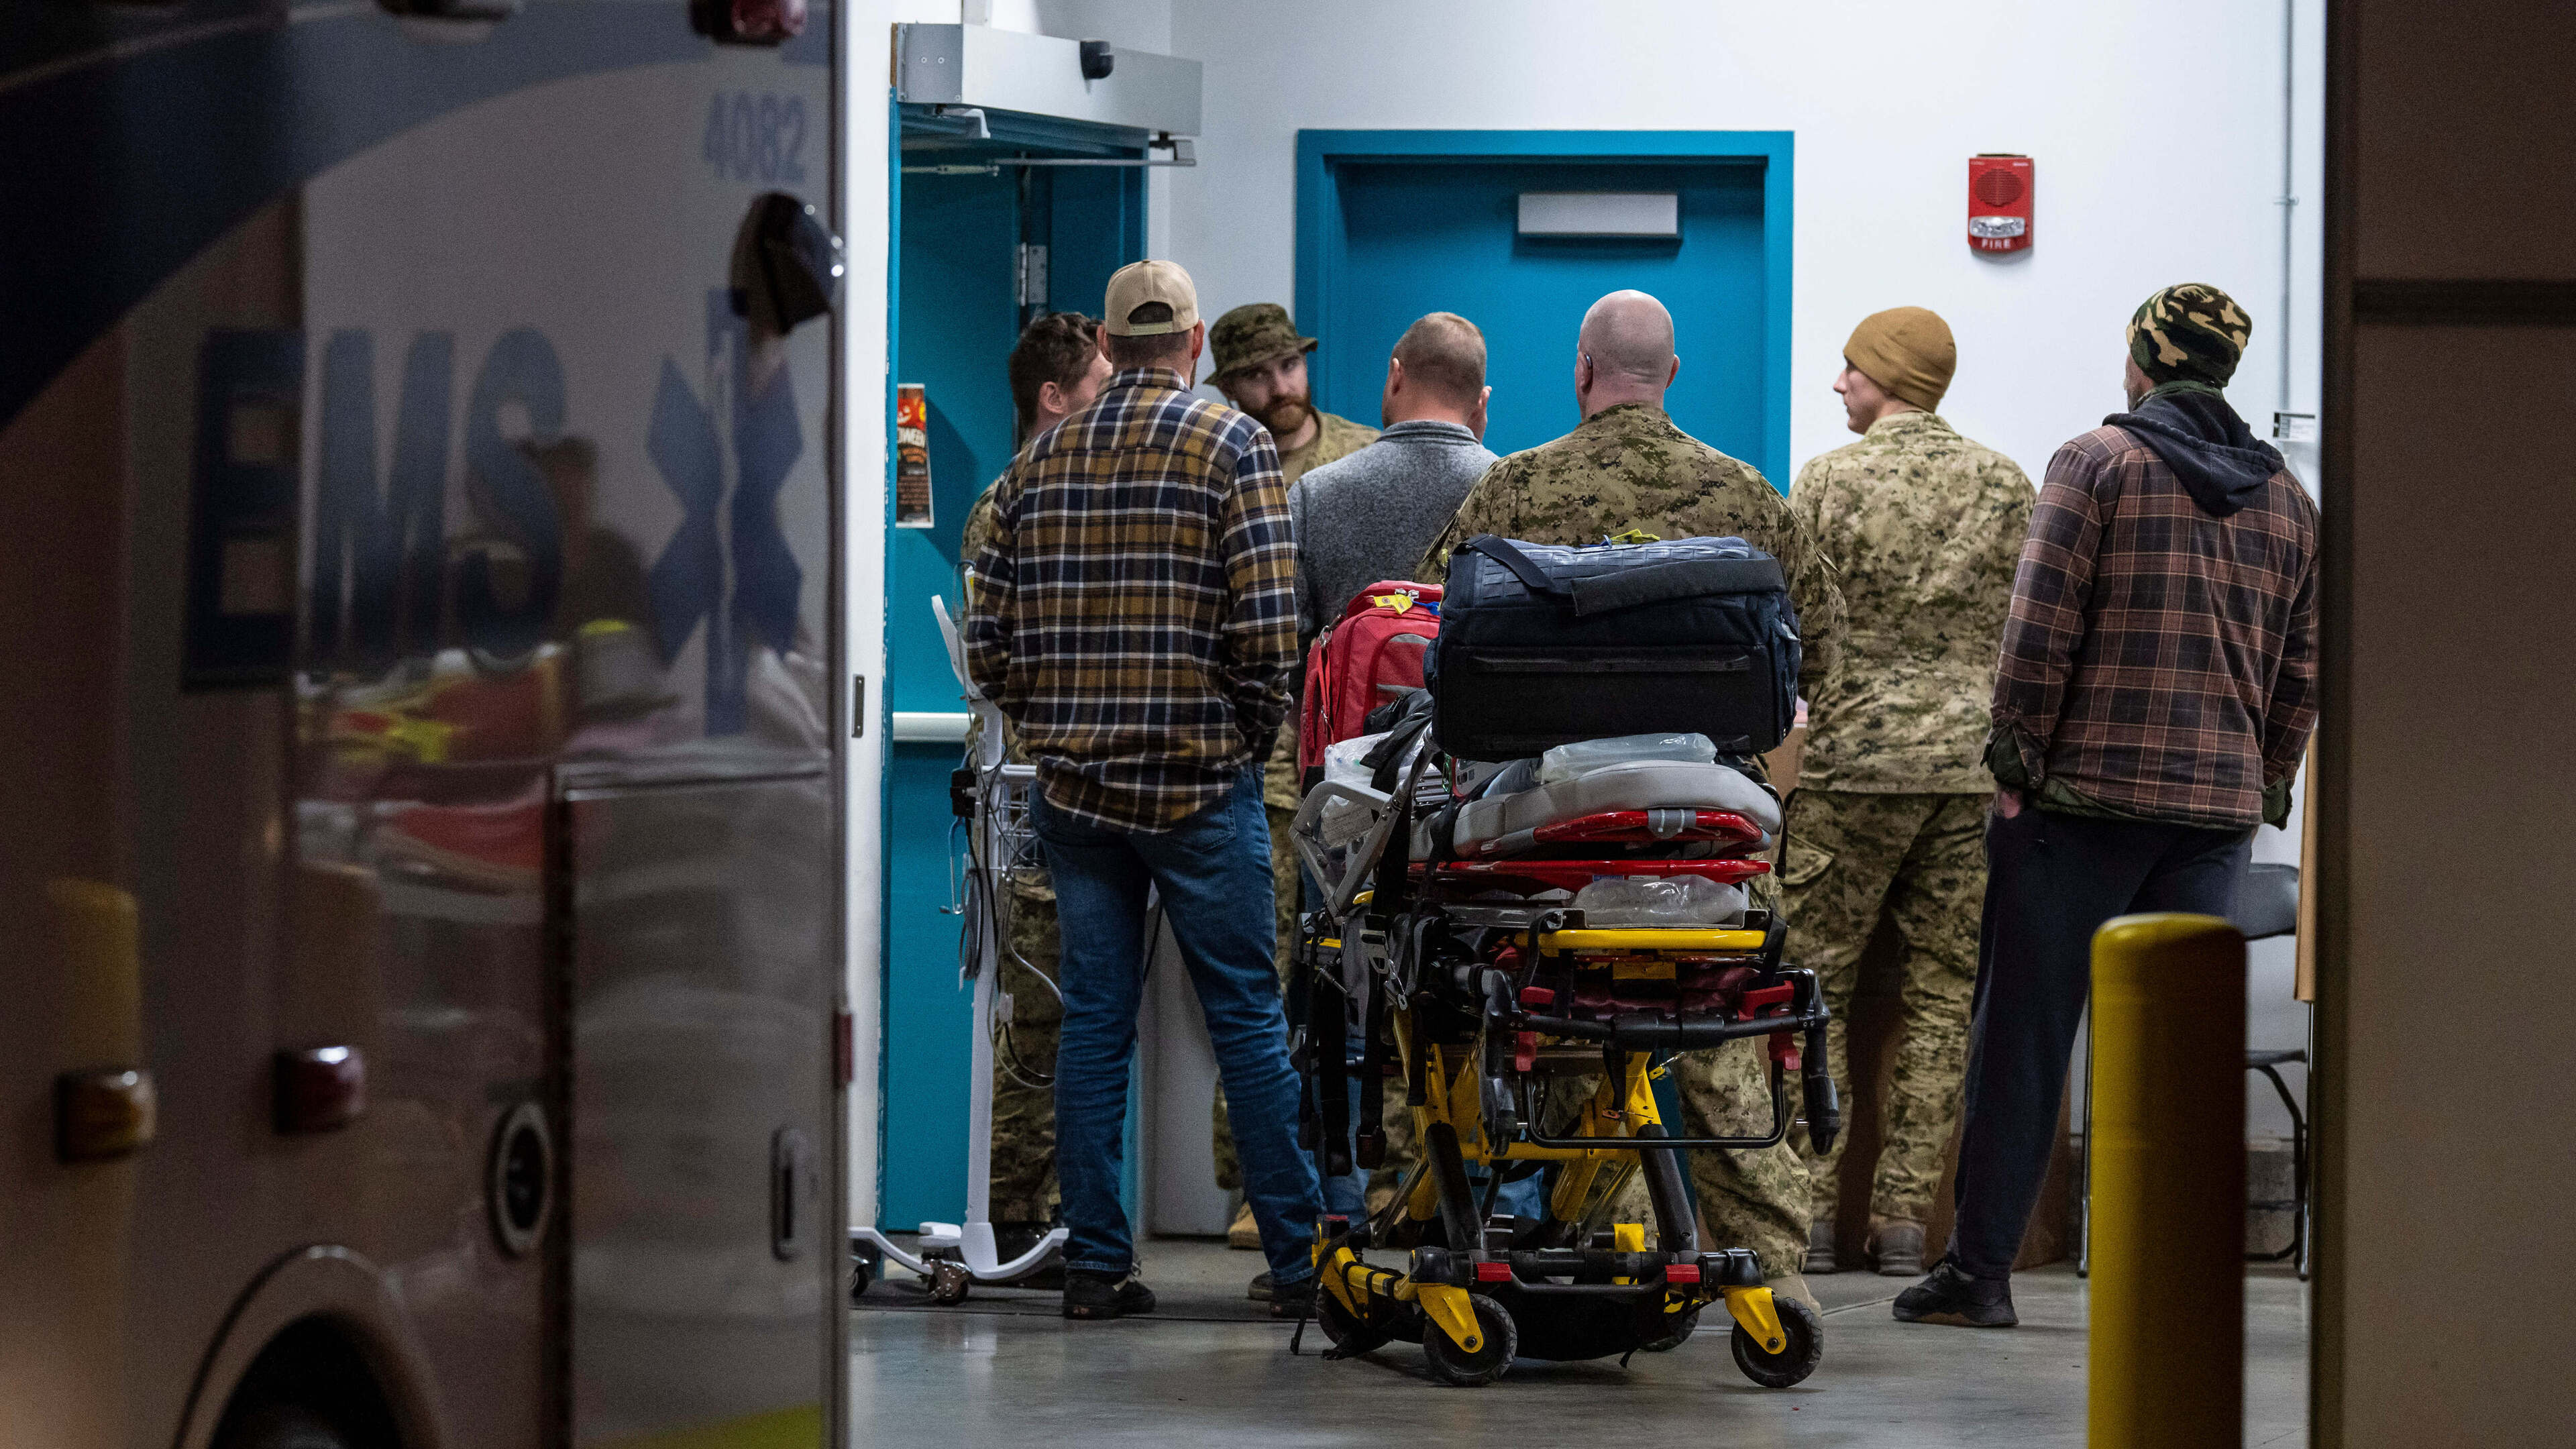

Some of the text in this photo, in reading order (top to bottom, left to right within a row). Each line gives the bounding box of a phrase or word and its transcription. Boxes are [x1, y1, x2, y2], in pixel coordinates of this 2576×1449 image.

[703, 92, 806, 181] 4082
[1982, 238, 2011, 249] FIRE
[184, 327, 567, 688] EMS
